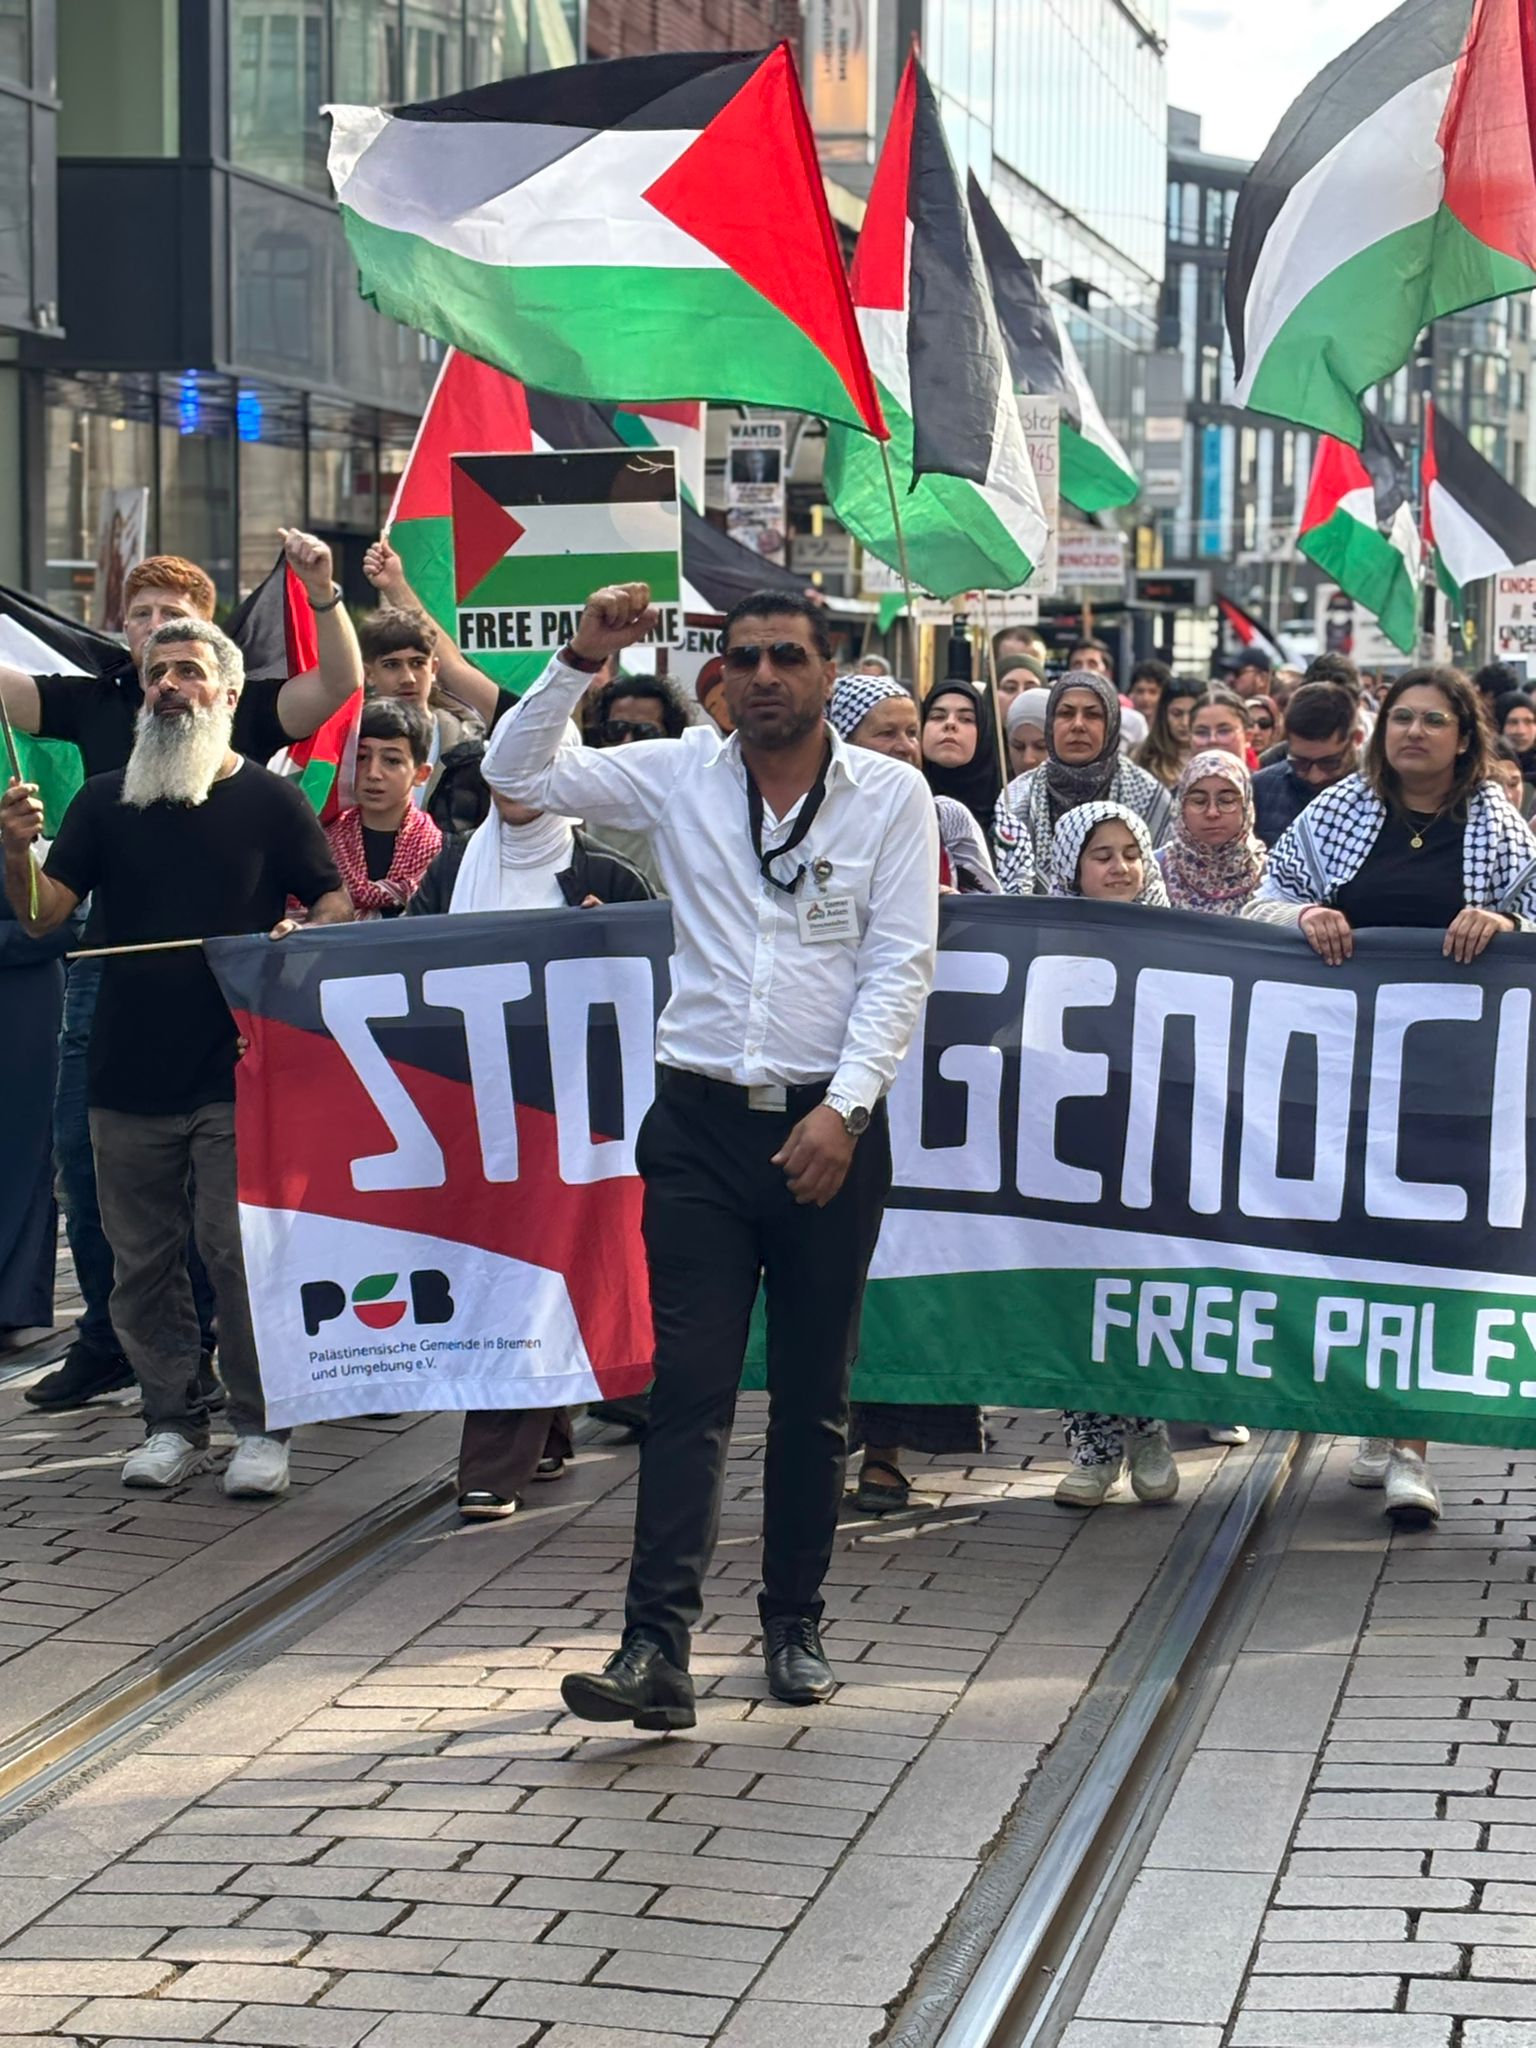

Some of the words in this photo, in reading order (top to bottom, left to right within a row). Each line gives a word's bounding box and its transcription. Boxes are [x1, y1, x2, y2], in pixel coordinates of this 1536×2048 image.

[731, 425, 781, 438] WANTED
[1028, 443, 1056, 473] 945
[1057, 554, 1121, 567] ENOZID
[1501, 578, 1536, 593] KINDE
[459, 612, 532, 650] FREE
[1500, 625, 1536, 641] KINDE
[319, 956, 656, 1191] STO
[1092, 1278, 1277, 1379] FREE
[309, 1341, 417, 1364] Palästinensische
[420, 1338, 481, 1352] Gemeinde
[483, 1337, 494, 1350] in
[496, 1336, 542, 1351] Bremen
[311, 1366, 338, 1381] und
[341, 1359, 413, 1377] Umgebung
[416, 1357, 437, 1370] e.V.
